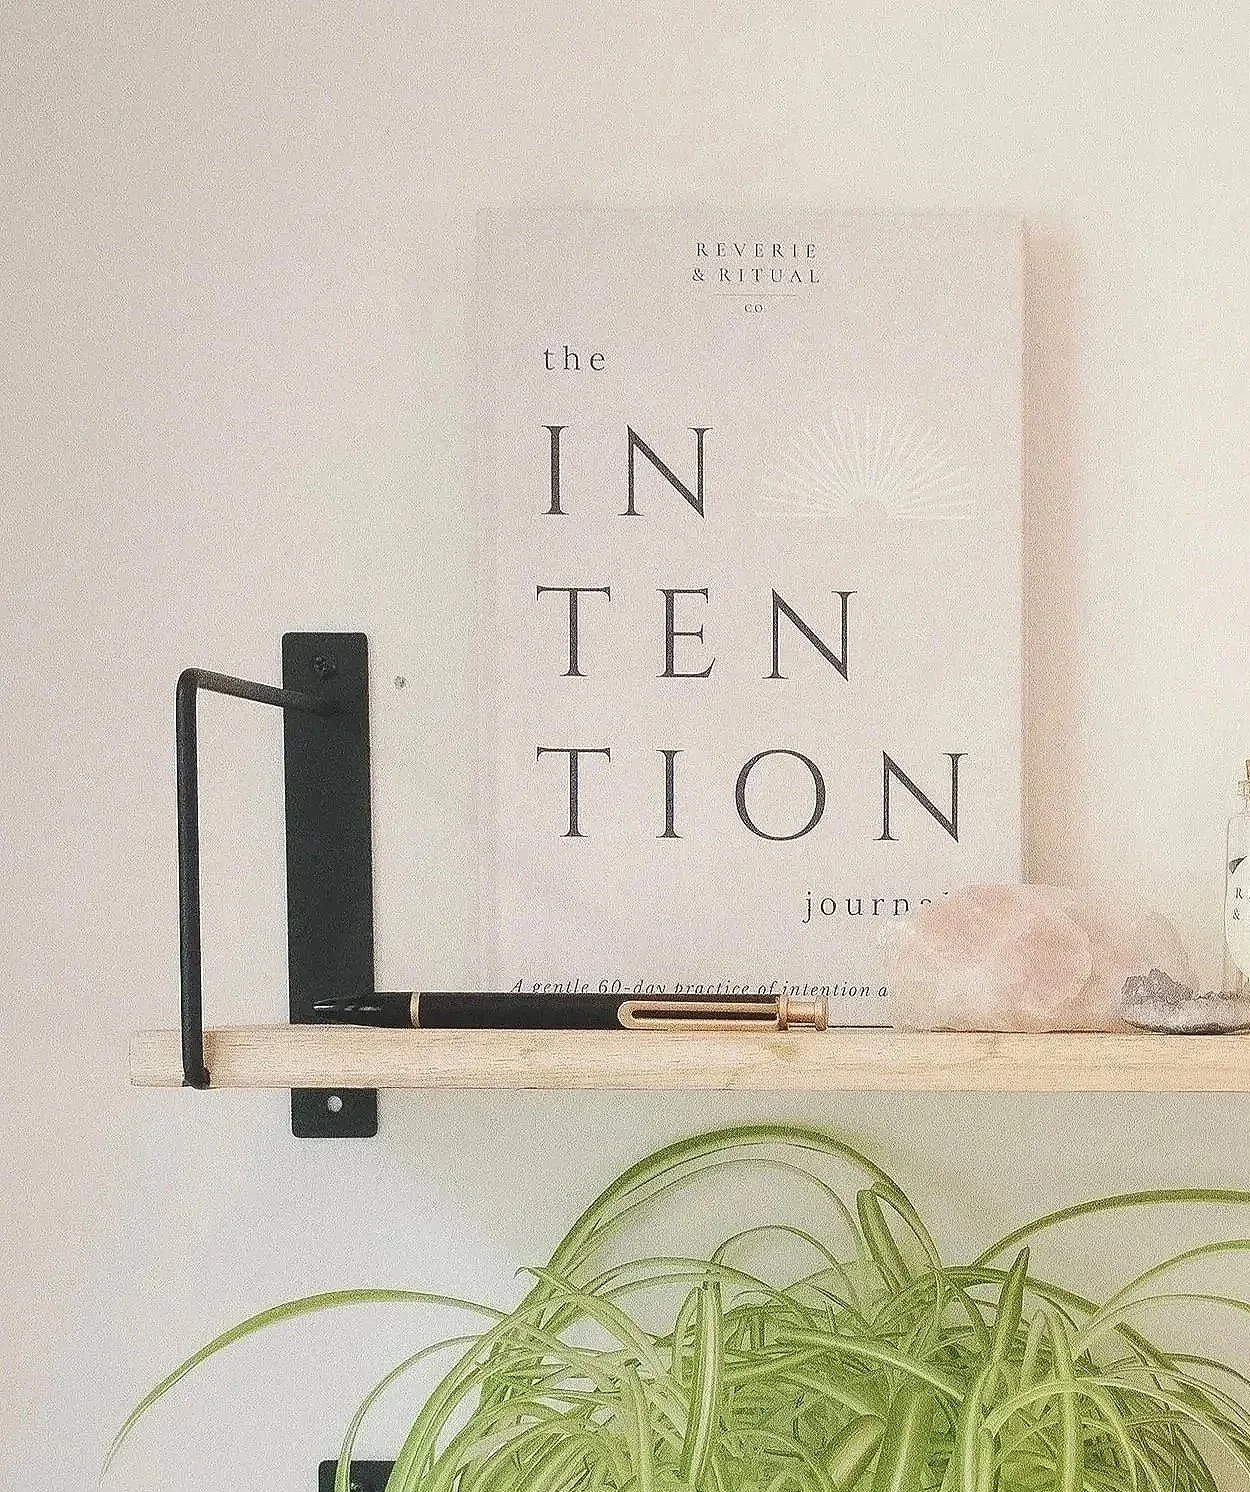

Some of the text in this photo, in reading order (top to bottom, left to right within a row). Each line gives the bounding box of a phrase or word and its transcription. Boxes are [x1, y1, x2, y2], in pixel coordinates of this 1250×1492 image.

[696, 242, 816, 259] REVERIE
[692, 267, 820, 283] & RITUAL
[543, 344, 606, 372] the
[541, 424, 713, 519] IN
[535, 585, 858, 682] TEN
[535, 746, 968, 844] TION
[801, 891, 949, 924] journ
[1232, 908, 1241, 921] &
[510, 978, 523, 993] A
[532, 978, 589, 993] gentle
[599, 979, 667, 993] 60-day
[674, 979, 749, 995] practice
[757, 980, 778, 995] of
[782, 980, 870, 997] intention
